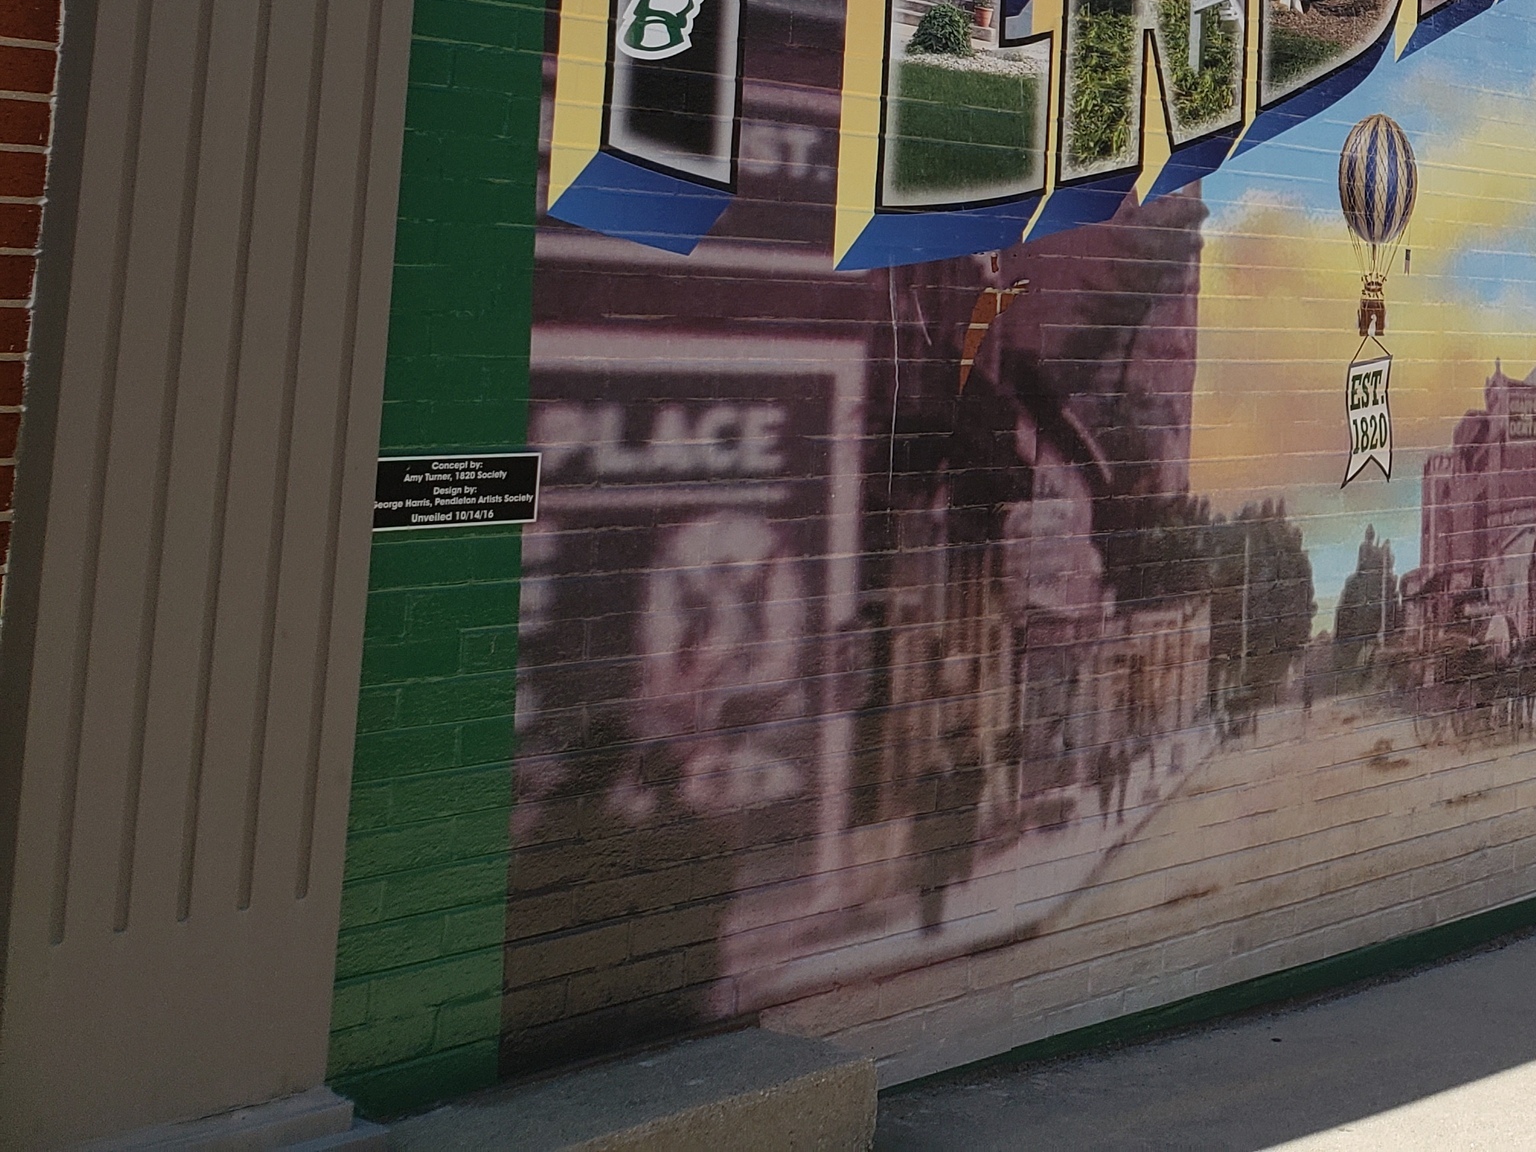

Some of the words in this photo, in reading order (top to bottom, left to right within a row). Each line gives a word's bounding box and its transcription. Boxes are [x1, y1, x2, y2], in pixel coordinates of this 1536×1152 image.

[1350, 369, 1385, 411] EST.
[531, 403, 787, 471] PLACE
[1352, 412, 1388, 455] 1820
[431, 461, 468, 471] Concept
[469, 460, 483, 470] by:
[403, 473, 423, 483] Amy
[425, 472, 453, 481] Turner,
[455, 471, 476, 480] 1820
[477, 470, 507, 480] Society
[433, 486, 462, 496] Design
[464, 485, 478, 495] by:
[405, 498, 433, 508] Harris,
[434, 496, 476, 506] Pendleton
[477, 494, 502, 504] Artists
[503, 493, 534, 503] Society
[411, 511, 453, 523] Unveiled
[455, 509, 494, 520] 10/14/16
